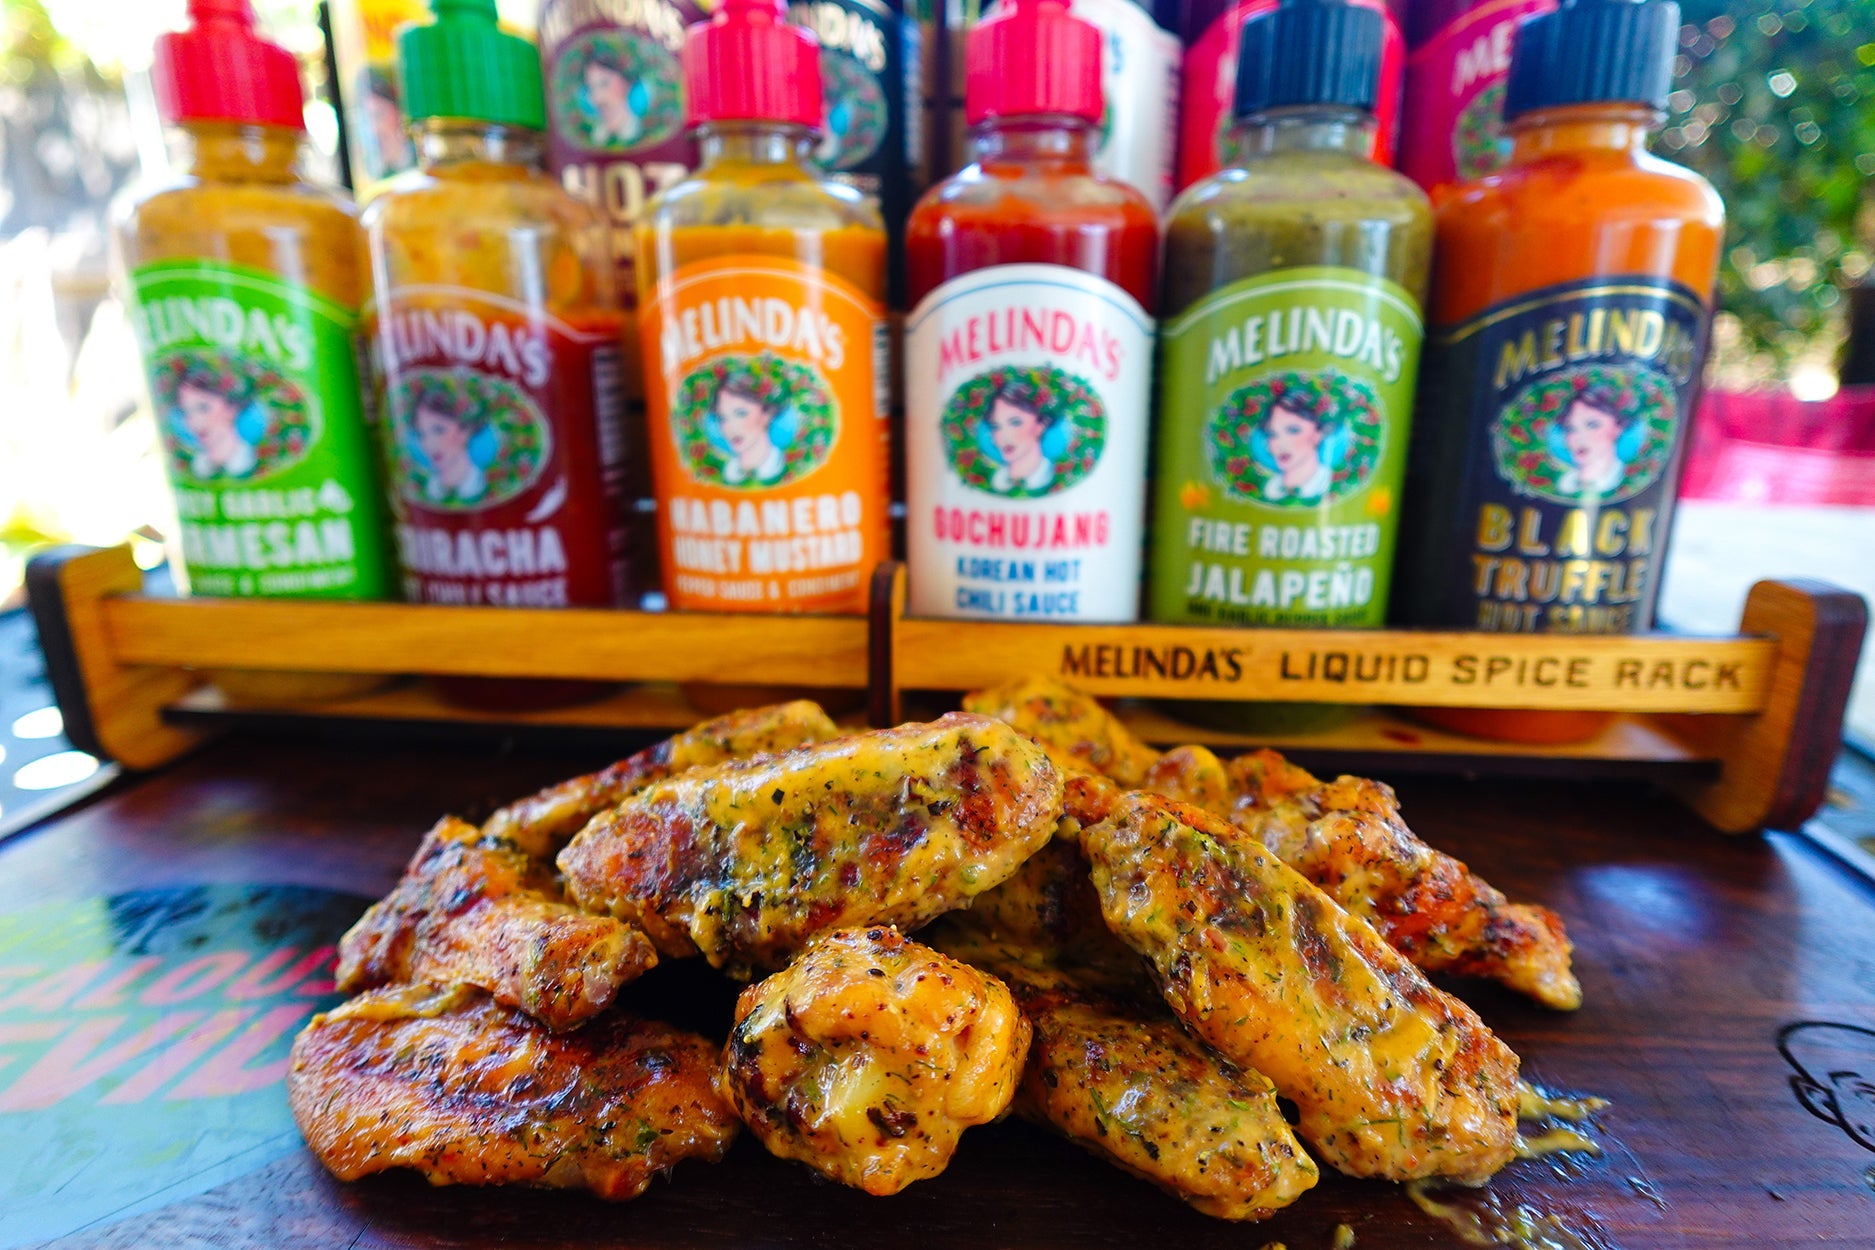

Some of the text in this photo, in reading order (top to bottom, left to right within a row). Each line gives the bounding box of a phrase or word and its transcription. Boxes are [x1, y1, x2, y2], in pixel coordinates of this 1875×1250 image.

[660, 296, 846, 372] MELINDA'S
[937, 306, 1126, 383] MELINDA'S
[1206, 304, 1403, 384] MELINDA'S
[669, 490, 863, 537] HABANERO
[933, 505, 1110, 550] GOCHUJANG
[1476, 502, 1657, 559] BLACK
[395, 522, 568, 578] RIRACHA
[747, 528, 864, 575] MUSTARD
[1188, 516, 1380, 561] FIRE ROASTED
[956, 556, 1081, 583] KOREAN HOT
[1185, 560, 1376, 611] JALAPEÑO
[1471, 551, 1649, 606] TRUFFLE
[1013, 590, 1079, 615] SAUCE
[1476, 602, 1542, 633] HOT
[1060, 643, 1745, 691] MELINDA'S LIQUID SPICE RACK
